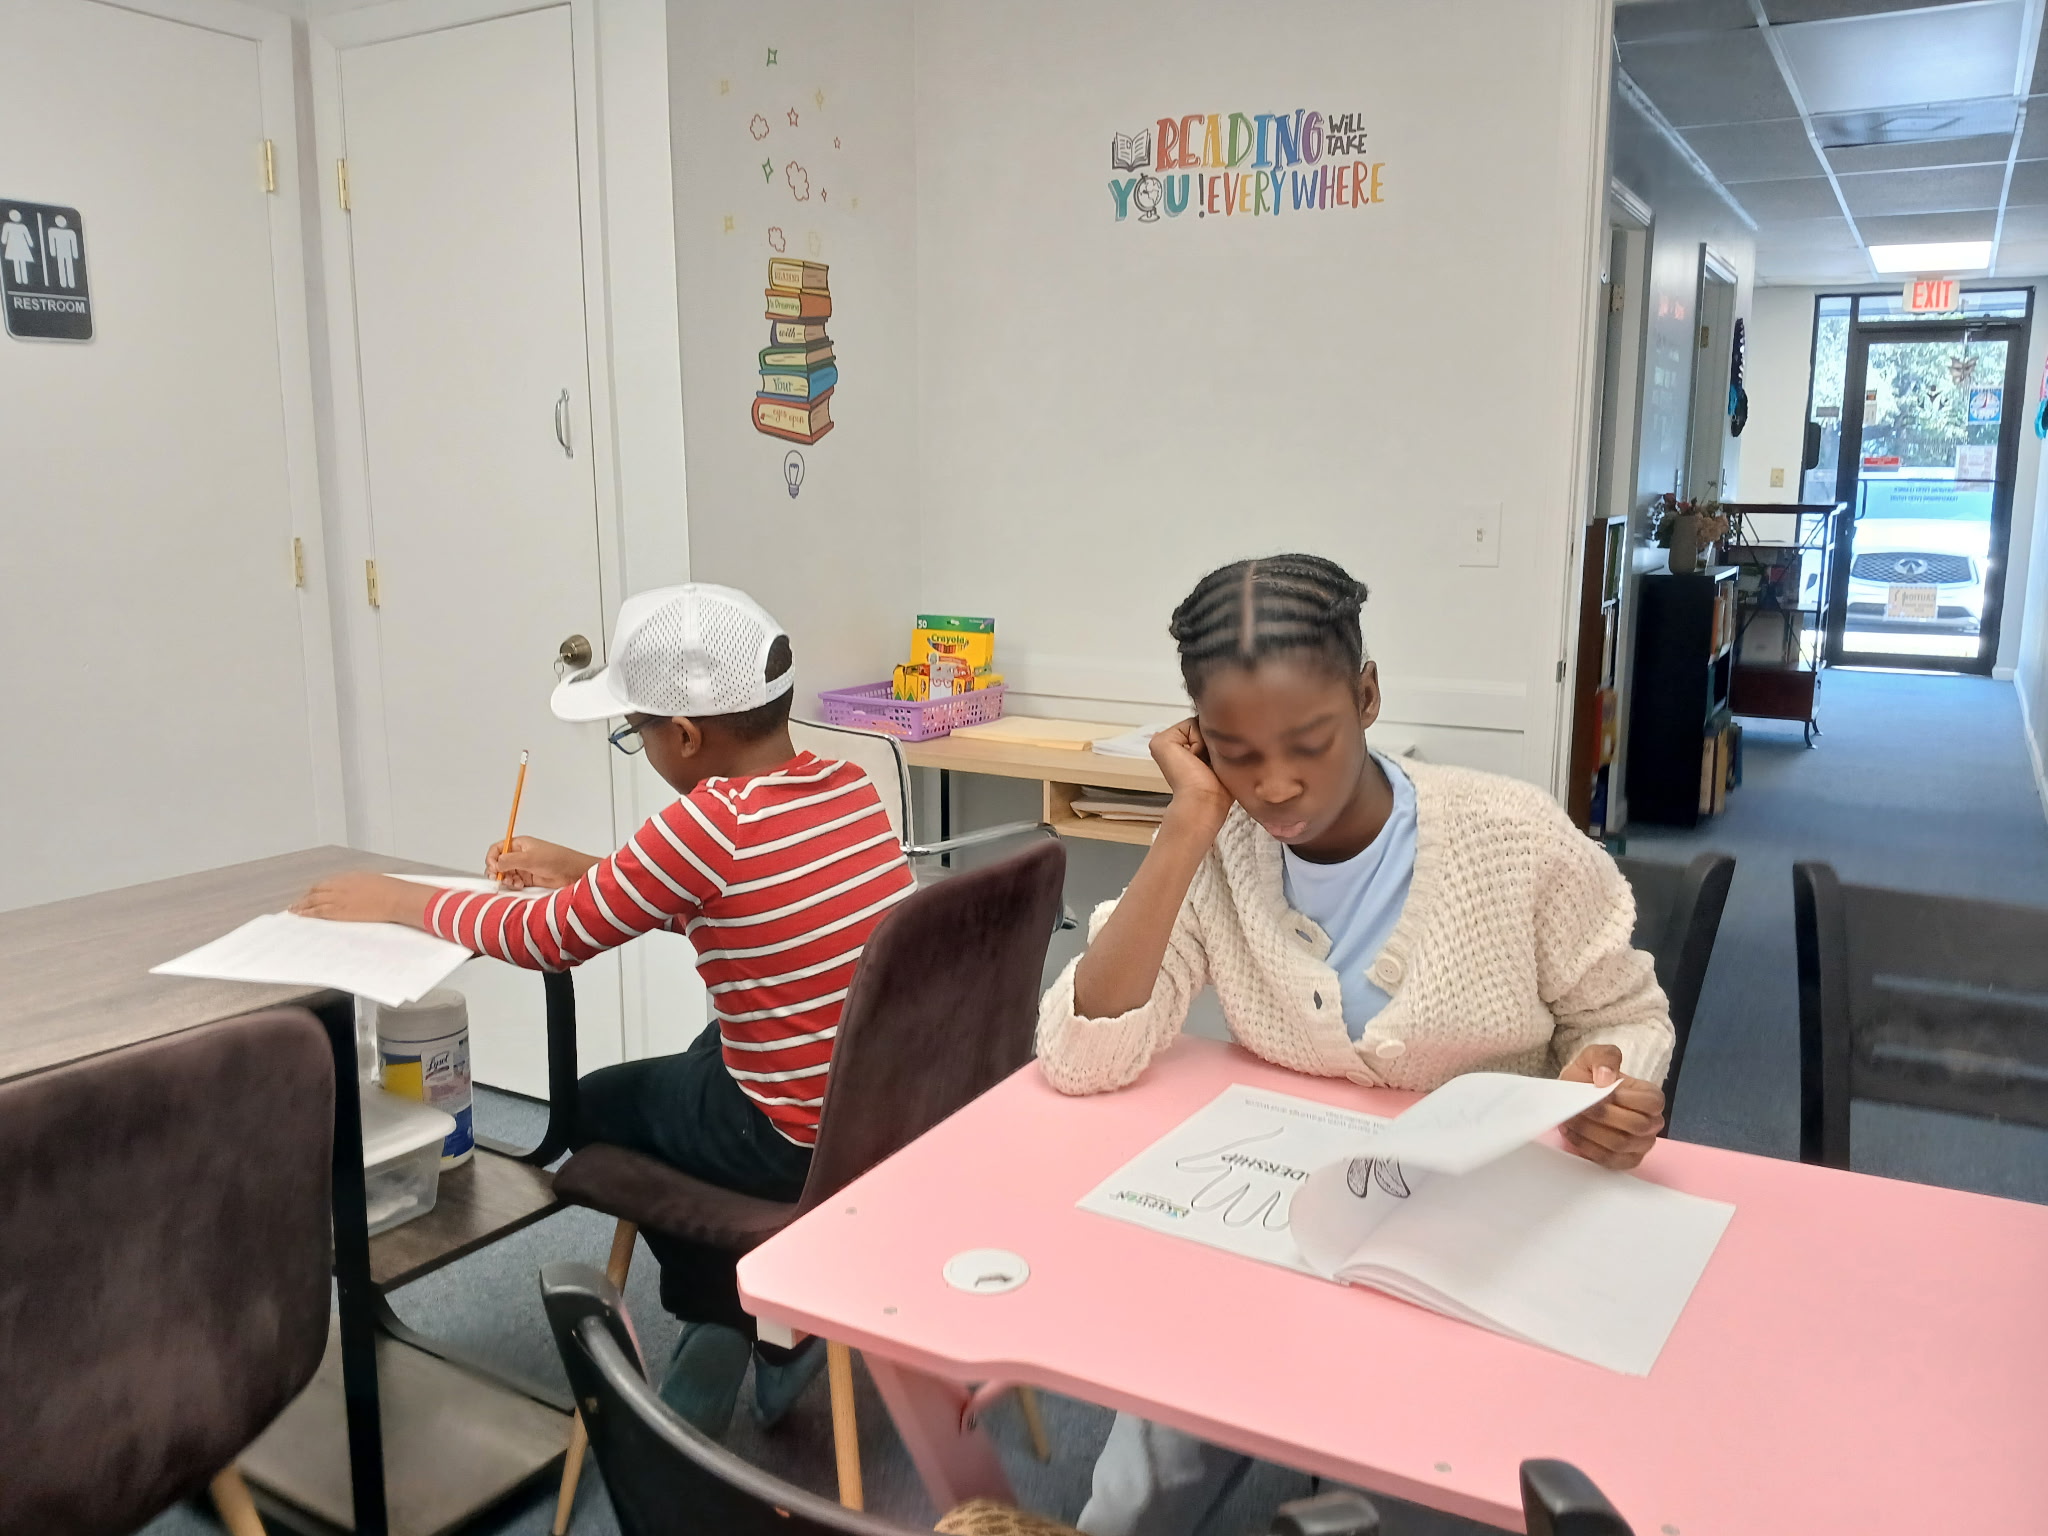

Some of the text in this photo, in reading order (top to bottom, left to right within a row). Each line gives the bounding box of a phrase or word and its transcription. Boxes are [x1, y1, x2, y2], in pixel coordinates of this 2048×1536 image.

[1155, 108, 1325, 172] READING
[1325, 134, 1368, 156] TAKE
[1108, 173, 1190, 223] YOU
[1912, 280, 1953, 309] EXIT
[13, 296, 86, 313] RESTROOM
[778, 327, 796, 338] with
[773, 377, 793, 393] Your
[917, 619, 928, 629] 50
[931, 633, 965, 644] Crayola
[427, 1051, 450, 1072] Lysol
